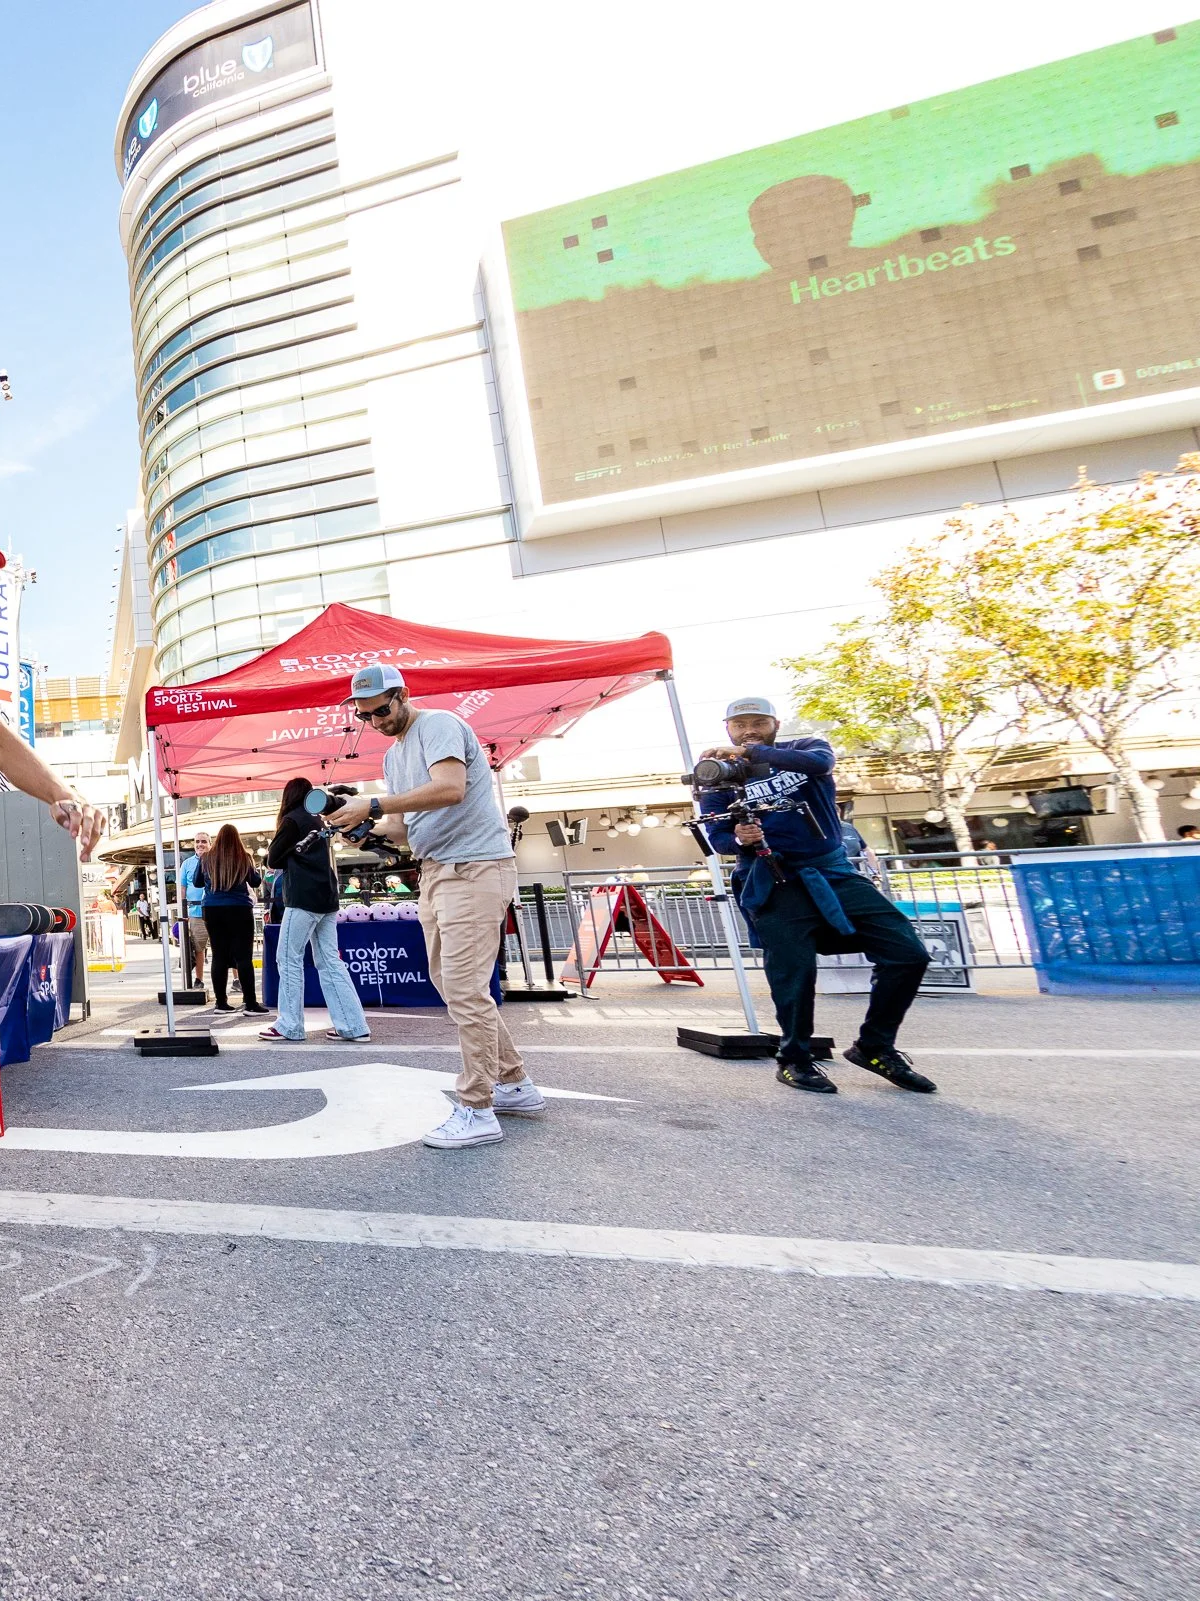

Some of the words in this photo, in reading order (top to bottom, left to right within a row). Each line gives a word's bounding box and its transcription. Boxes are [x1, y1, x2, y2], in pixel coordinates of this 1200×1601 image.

[184, 59, 238, 94] blue
[192, 71, 245, 98] california
[789, 235, 1017, 305] Heartbeats
[574, 464, 623, 482] ESPN
[305, 647, 417, 664] TOYOTA
[283, 659, 380, 673] SPORTS
[154, 692, 203, 706] SPORTS
[177, 698, 237, 714] FESTIVAL
[744, 781, 774, 800] ENN
[345, 947, 408, 961] TOYOTA
[343, 960, 388, 973] PORTS
[359, 971, 427, 986] FESTIVAL
